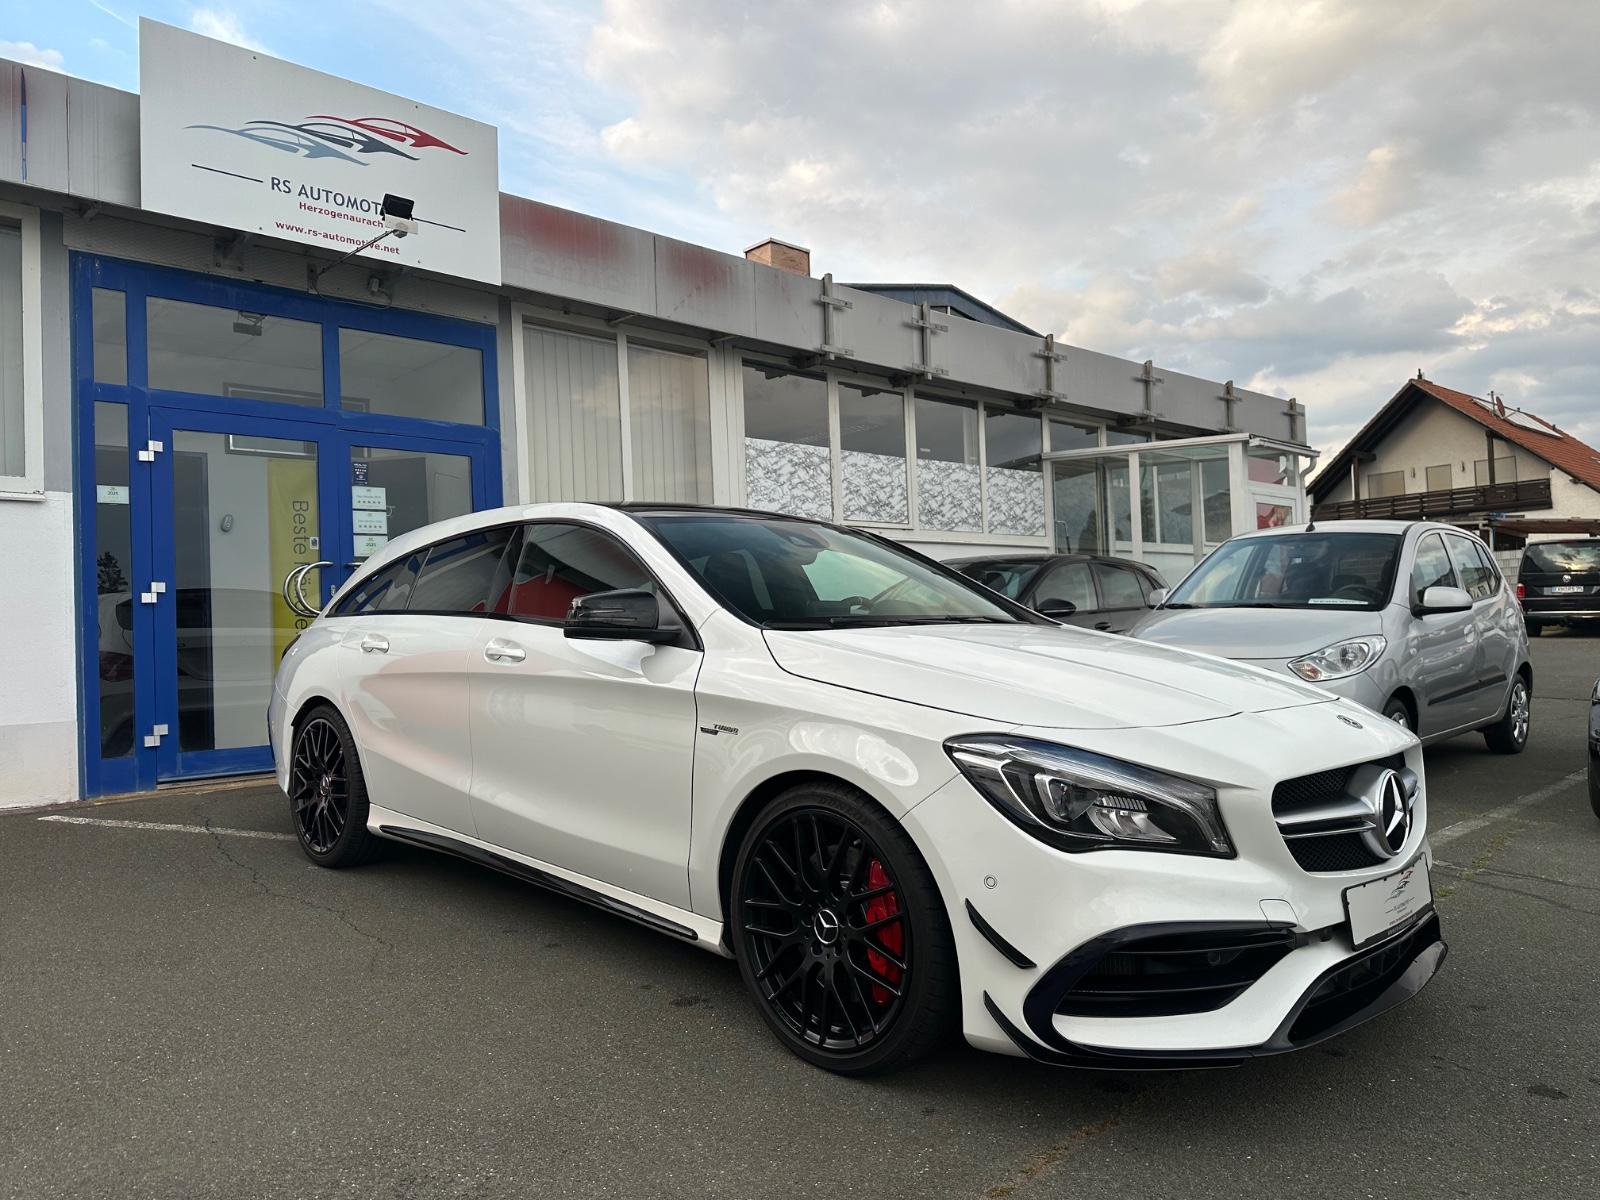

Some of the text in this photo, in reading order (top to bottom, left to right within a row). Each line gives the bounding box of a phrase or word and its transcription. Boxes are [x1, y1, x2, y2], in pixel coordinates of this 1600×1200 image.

[271, 176, 382, 215] RS AUTOMOT
[299, 201, 384, 229] Herzogenaurach
[292, 500, 310, 555] Beste
